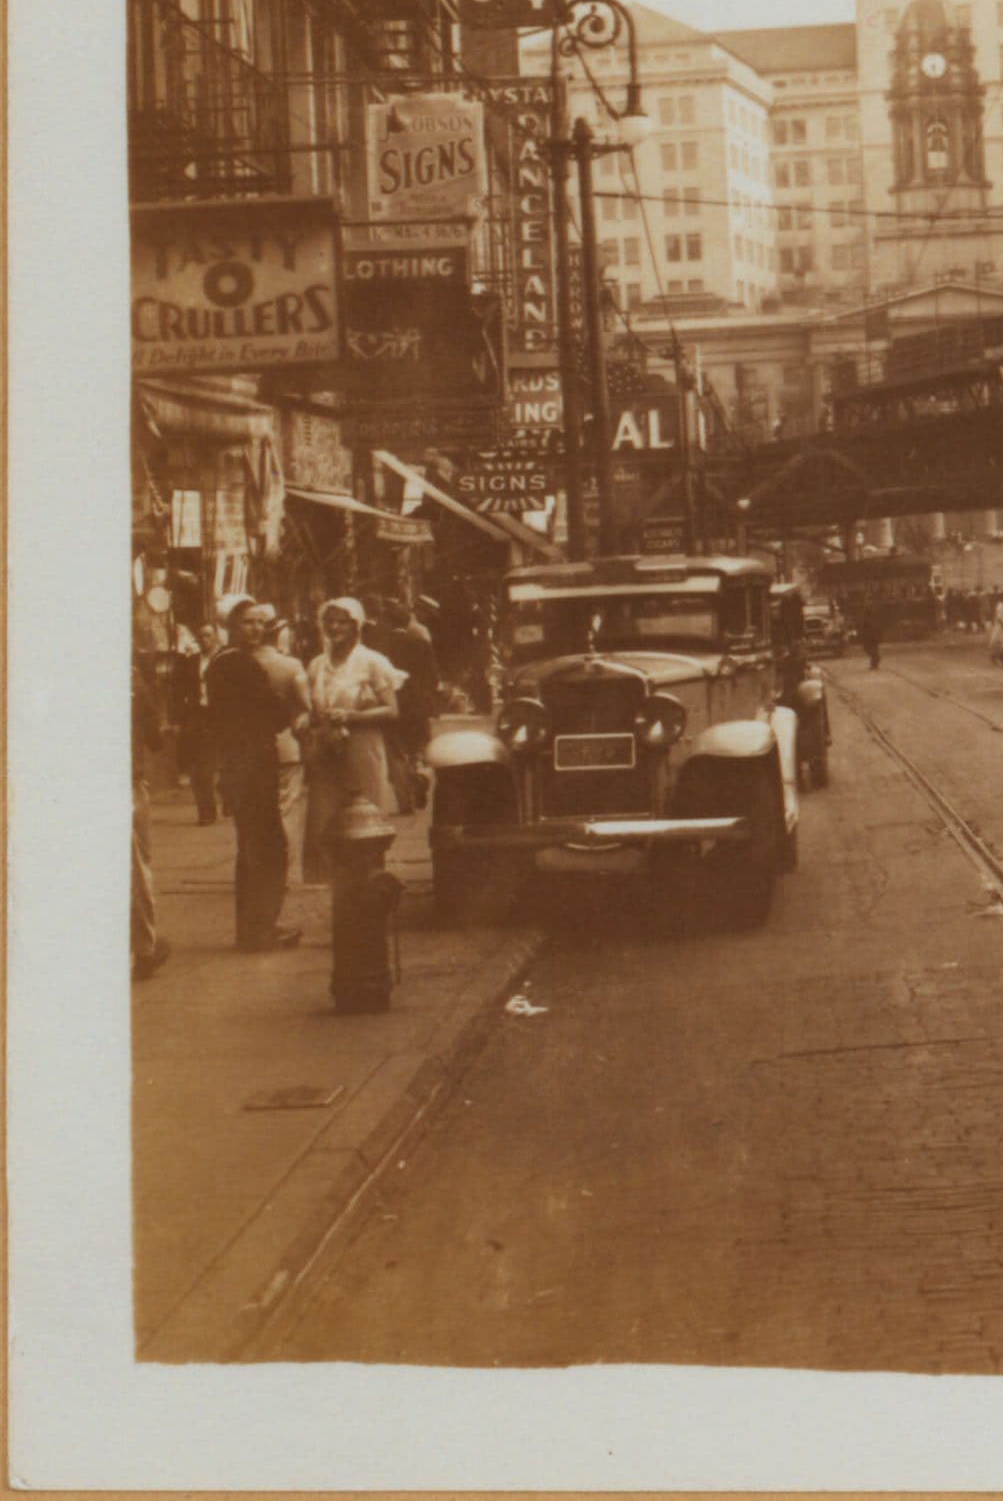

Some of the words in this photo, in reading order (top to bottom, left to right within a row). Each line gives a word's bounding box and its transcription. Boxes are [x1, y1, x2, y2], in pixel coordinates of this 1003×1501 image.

[379, 137, 476, 195] SIGNS
[148, 227, 304, 281] TASTY
[516, 112, 549, 352] DANCELAND
[342, 258, 454, 280] LOTHING
[132, 283, 332, 342] CRULLERS
[458, 474, 547, 492] SIGNS
